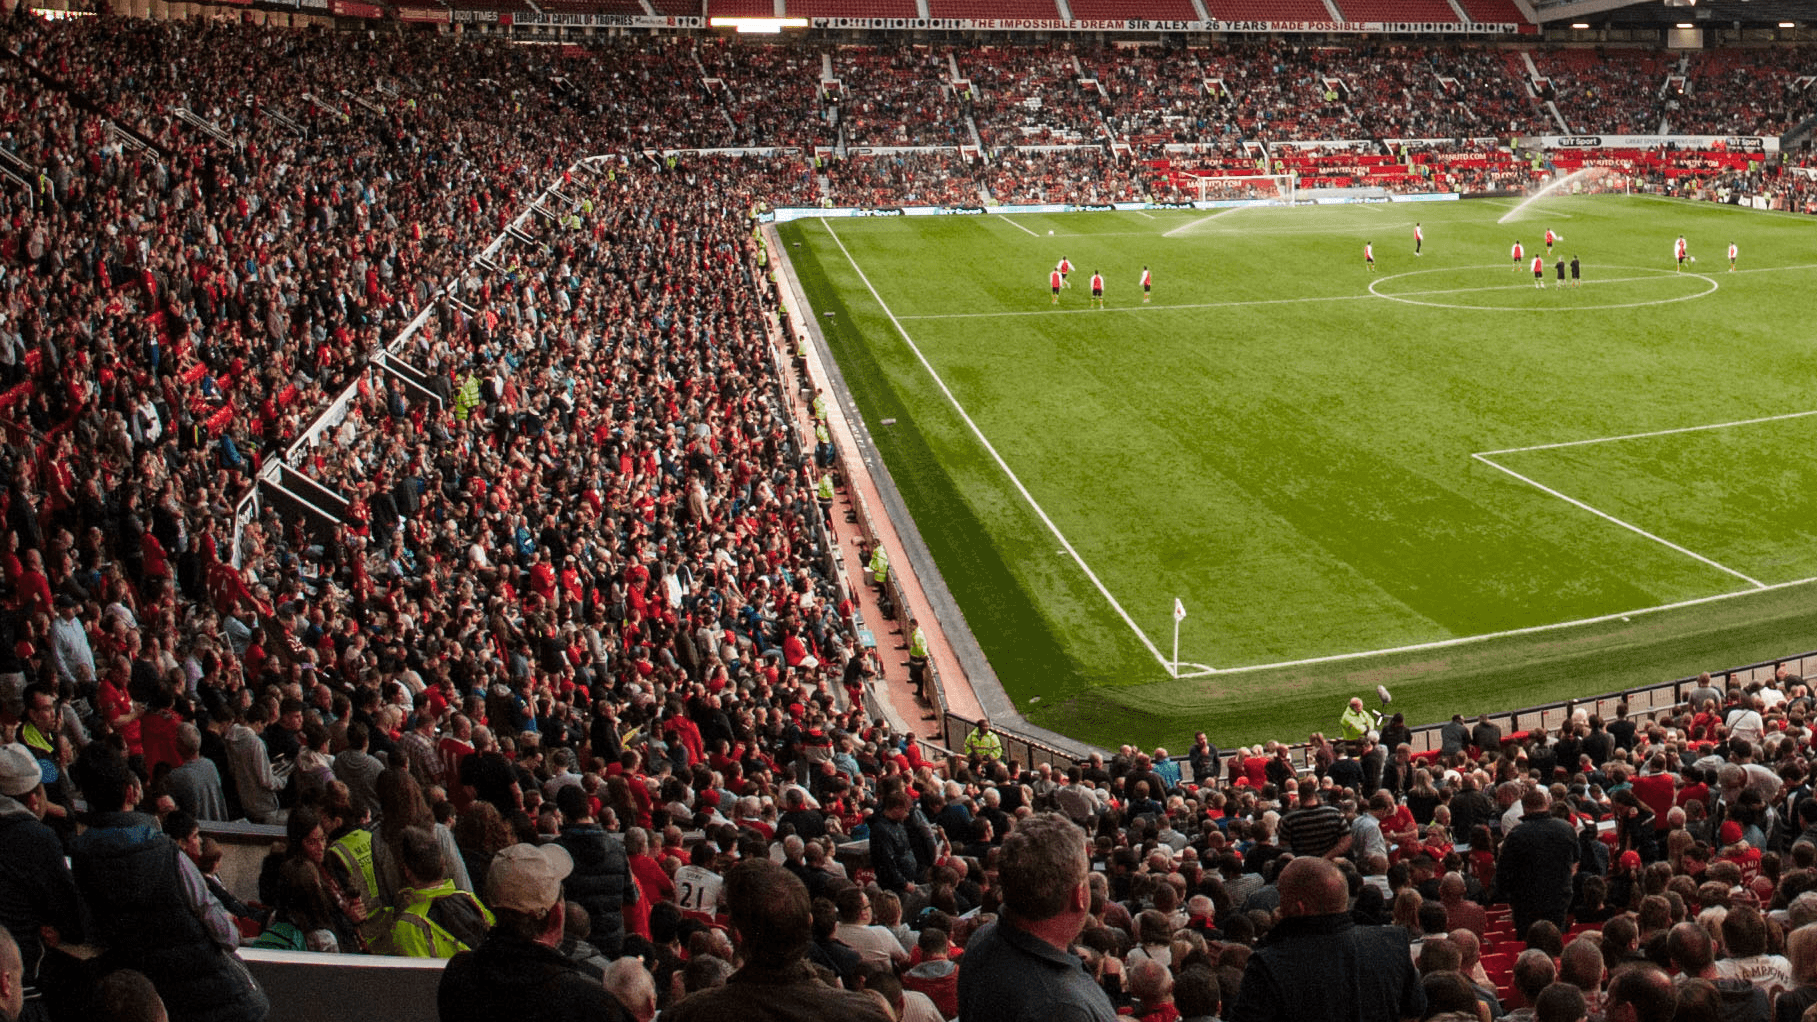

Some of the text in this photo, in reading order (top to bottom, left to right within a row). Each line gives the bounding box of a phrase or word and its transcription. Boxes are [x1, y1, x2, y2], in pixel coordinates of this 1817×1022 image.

[971, 19, 995, 29] THE
[1000, 19, 1077, 29] IMPOSSIBLE
[1081, 19, 1125, 29] DREAM
[1128, 20, 1150, 30] SIR
[1155, 20, 1189, 30] ALEX
[1205, 21, 1220, 30] 26
[1225, 21, 1268, 31] YEARS
[1271, 21, 1305, 31] MADE
[1575, 137, 1598, 146] Sport
[680, 882, 705, 909] 21
